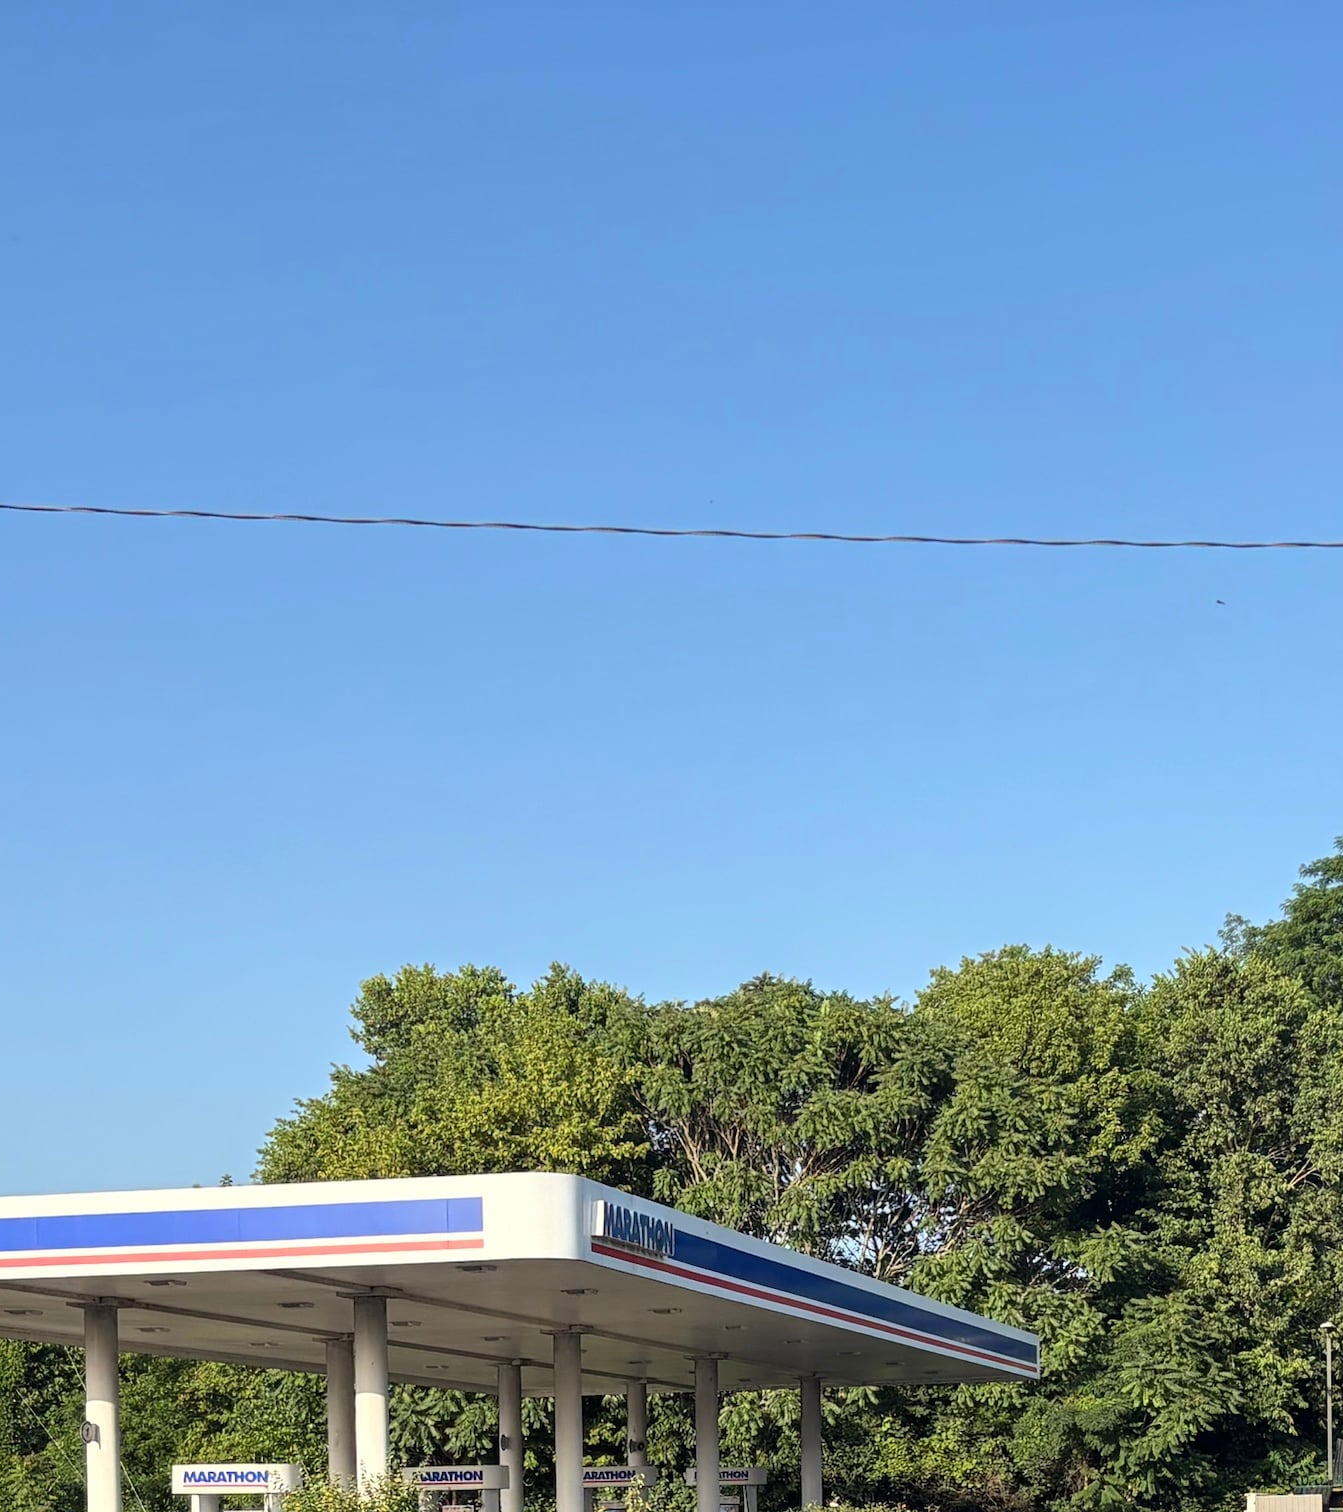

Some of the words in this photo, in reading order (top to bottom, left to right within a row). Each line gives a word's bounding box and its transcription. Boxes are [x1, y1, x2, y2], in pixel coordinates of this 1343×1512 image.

[603, 1201, 674, 1255] MARATHON
[183, 1470, 269, 1484] MARATHON
[582, 1469, 637, 1481] ARATHON
